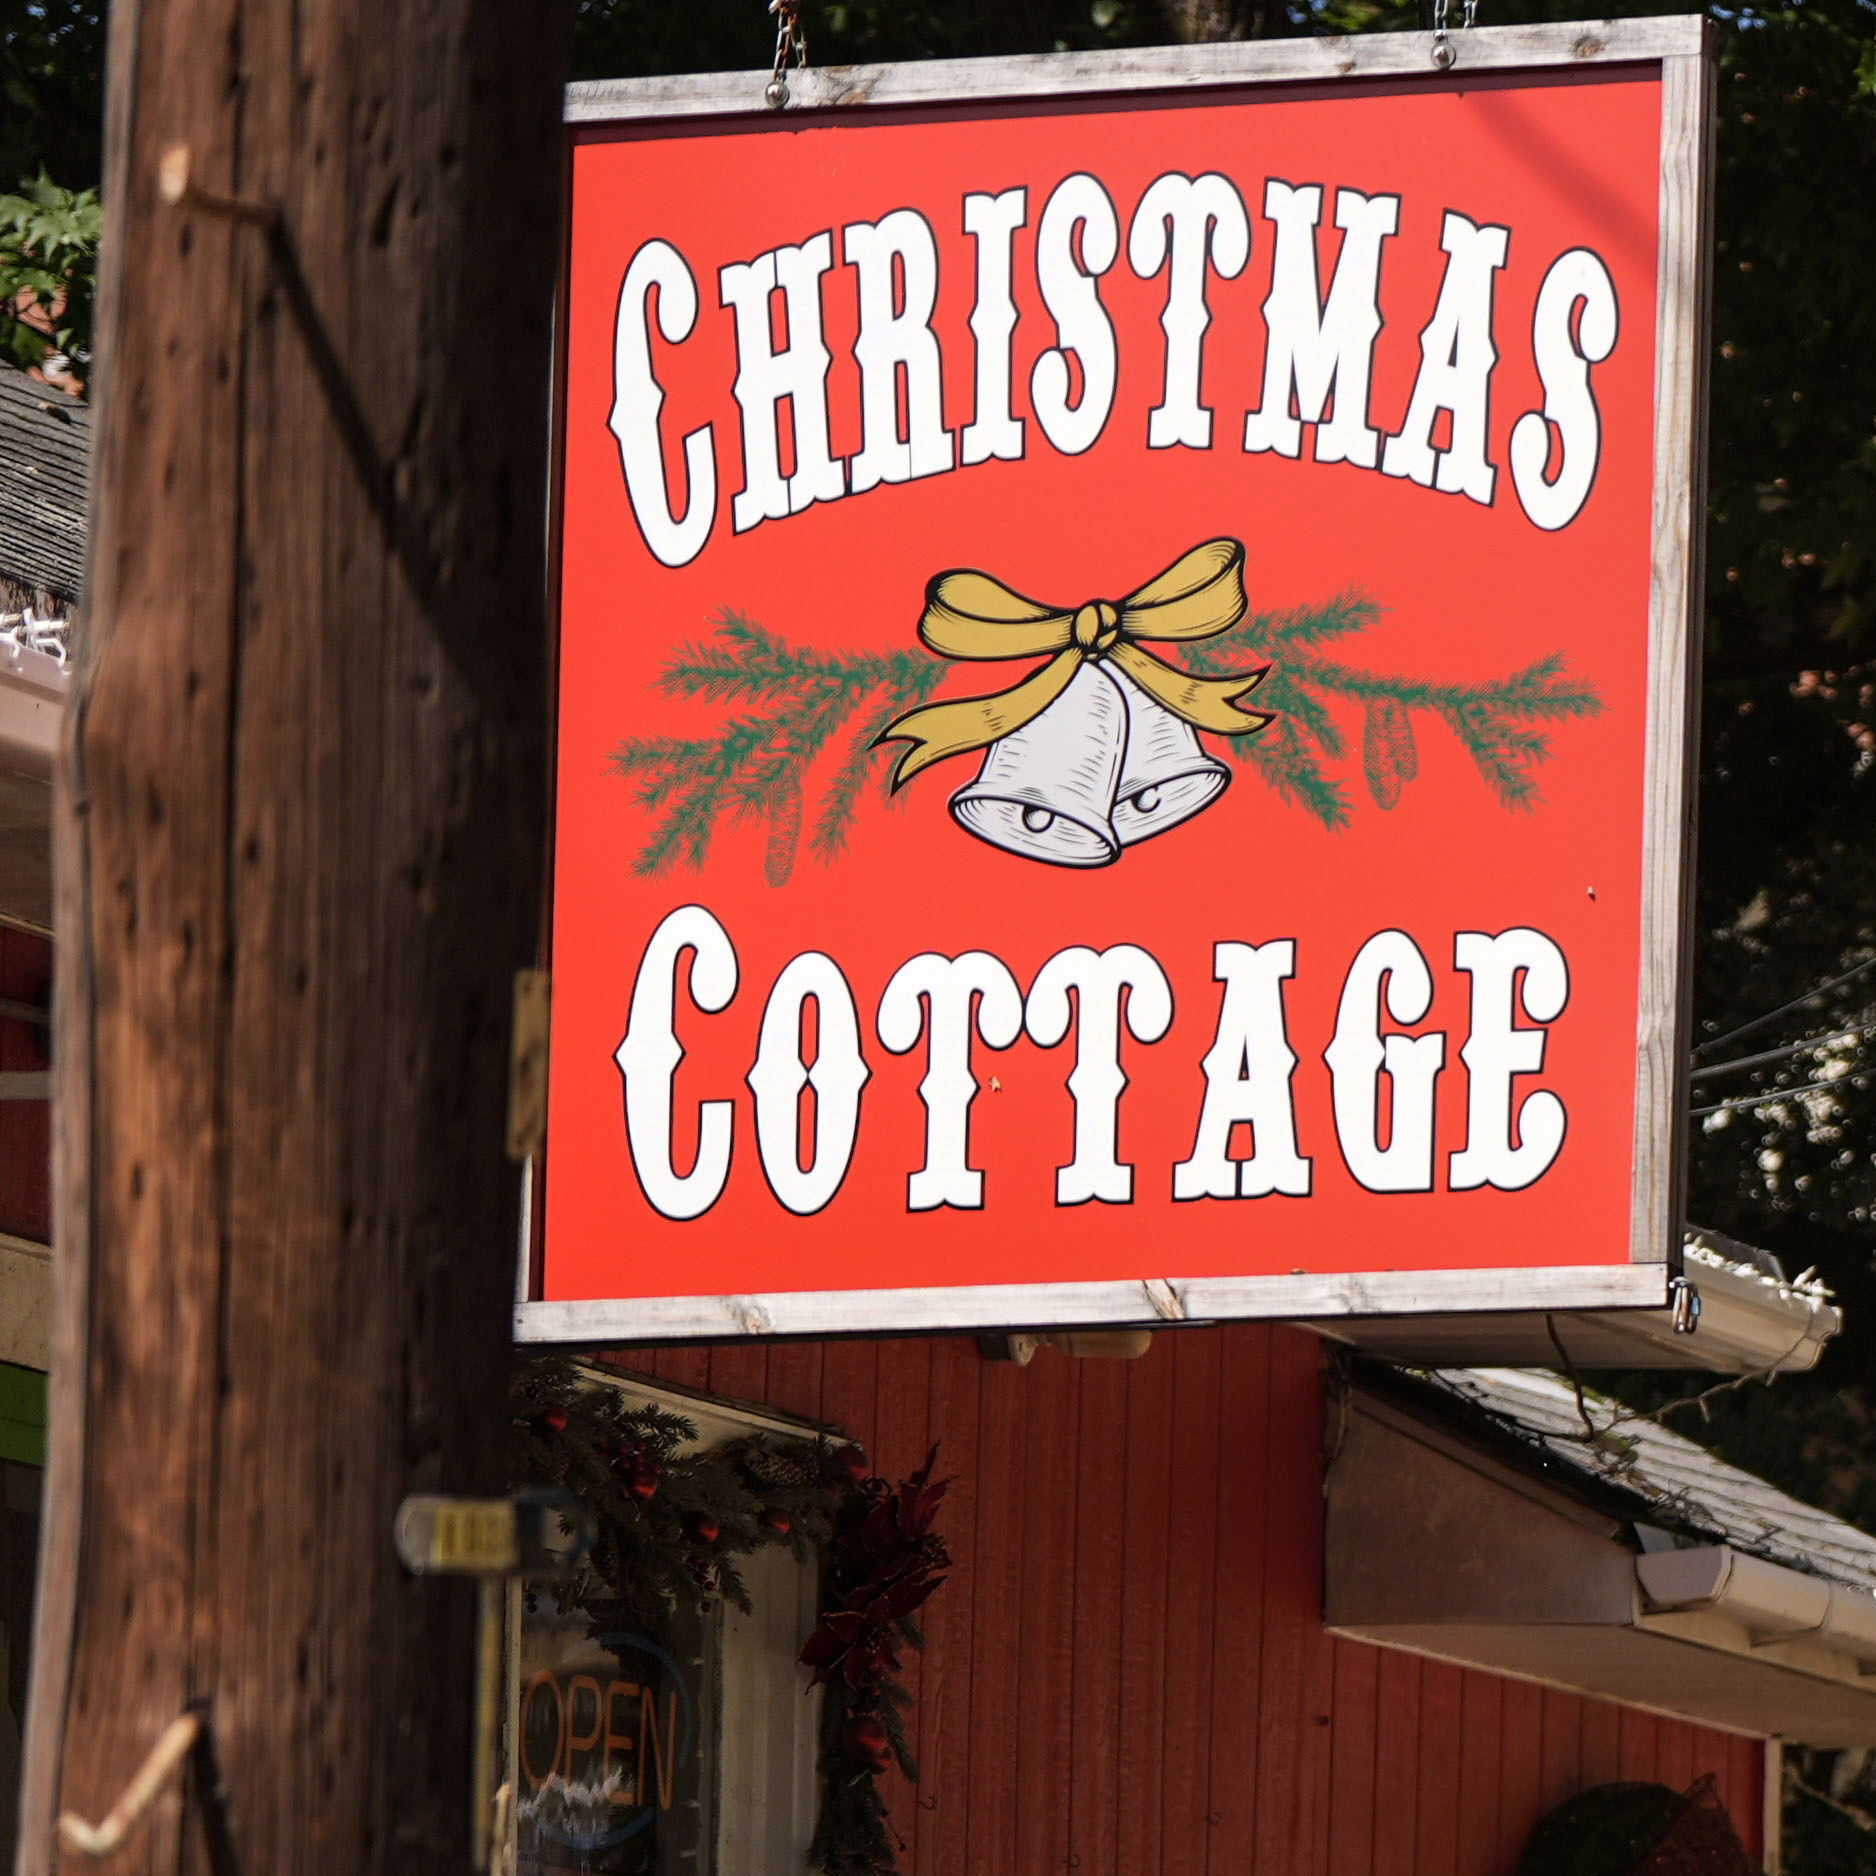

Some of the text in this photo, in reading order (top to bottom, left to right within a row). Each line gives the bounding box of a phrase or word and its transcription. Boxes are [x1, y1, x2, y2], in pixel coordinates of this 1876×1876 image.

[606, 171, 1620, 567] CHRISTMAS
[613, 904, 1570, 1220] COTTAGE
[520, 1669, 677, 1809] OPEN
